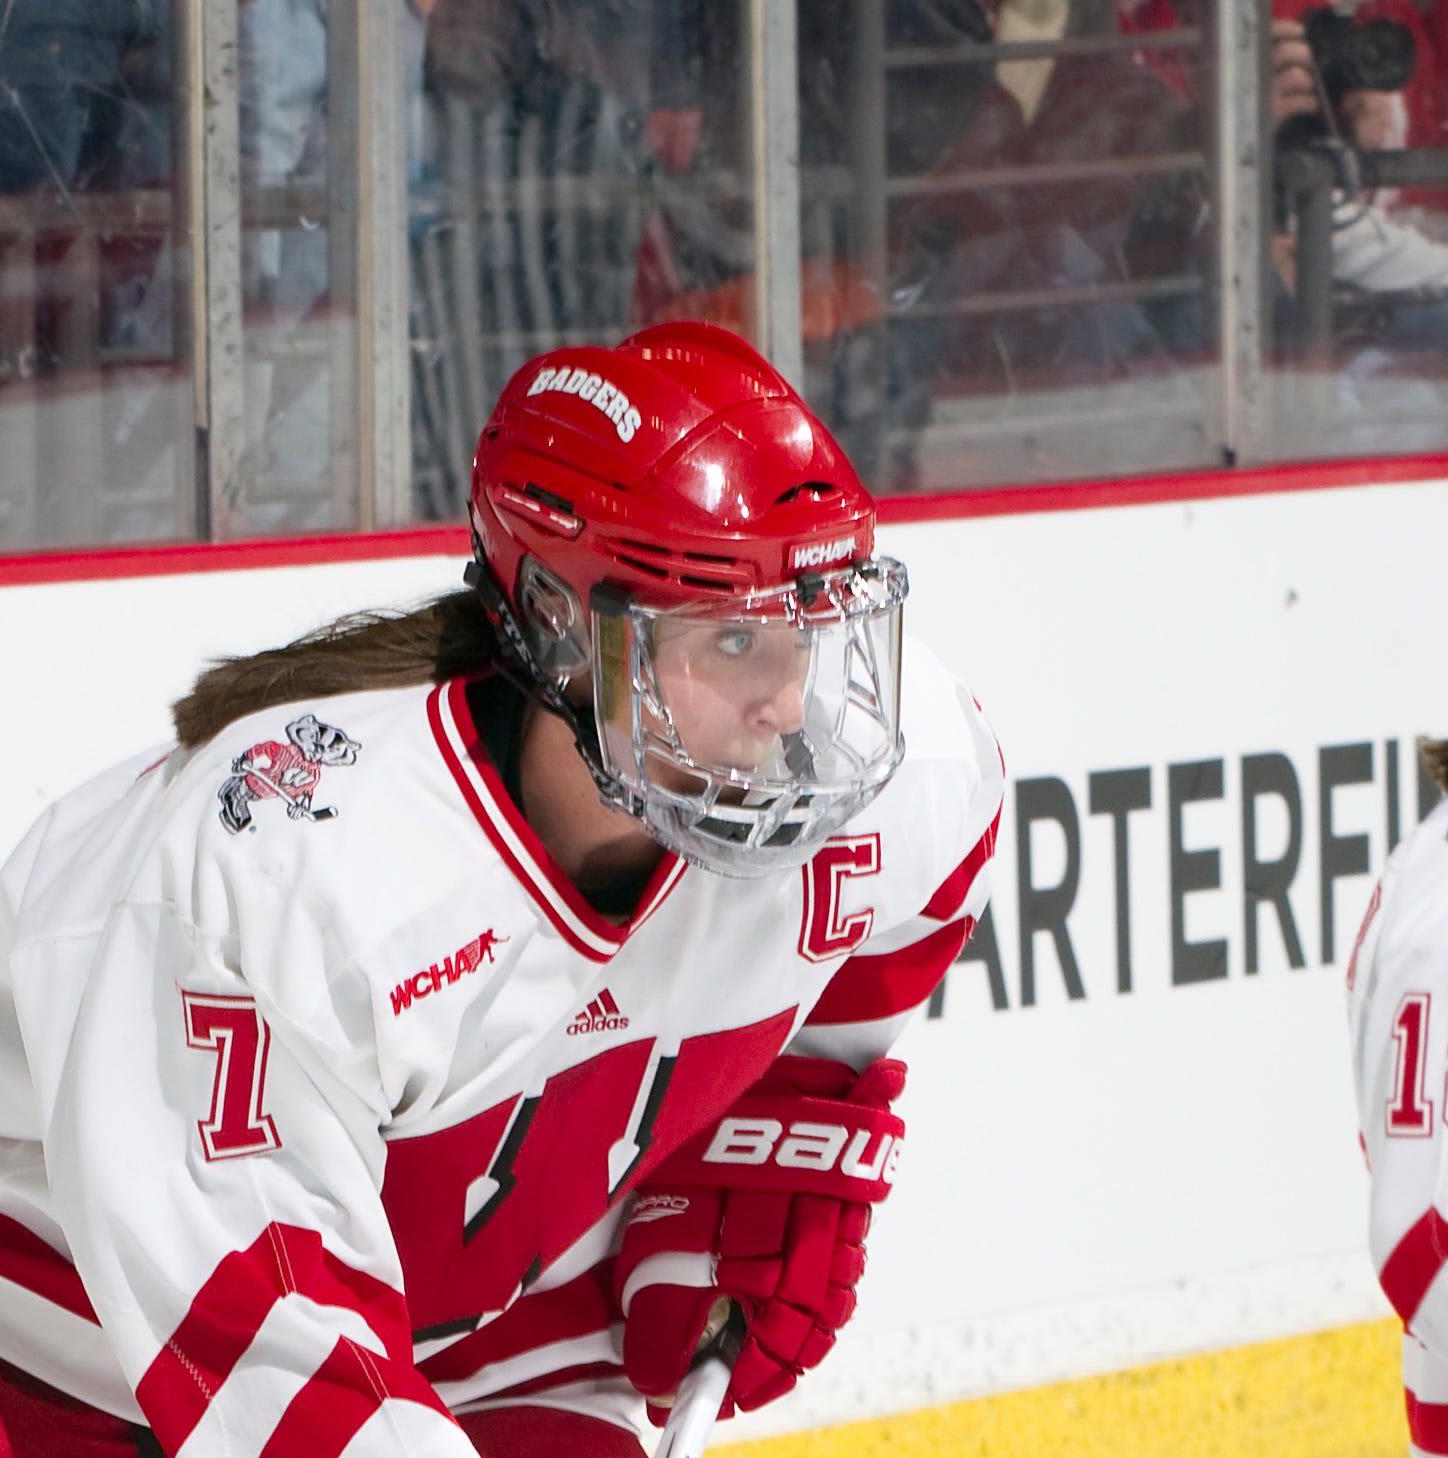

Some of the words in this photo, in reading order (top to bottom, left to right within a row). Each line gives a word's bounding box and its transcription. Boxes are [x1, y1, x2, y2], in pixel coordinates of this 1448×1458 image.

[526, 365, 642, 444] BADGERS
[797, 832, 882, 964] C
[389, 948, 473, 1018] WCHA
[566, 1016, 630, 1037] adidas
[180, 989, 284, 1163] 7
